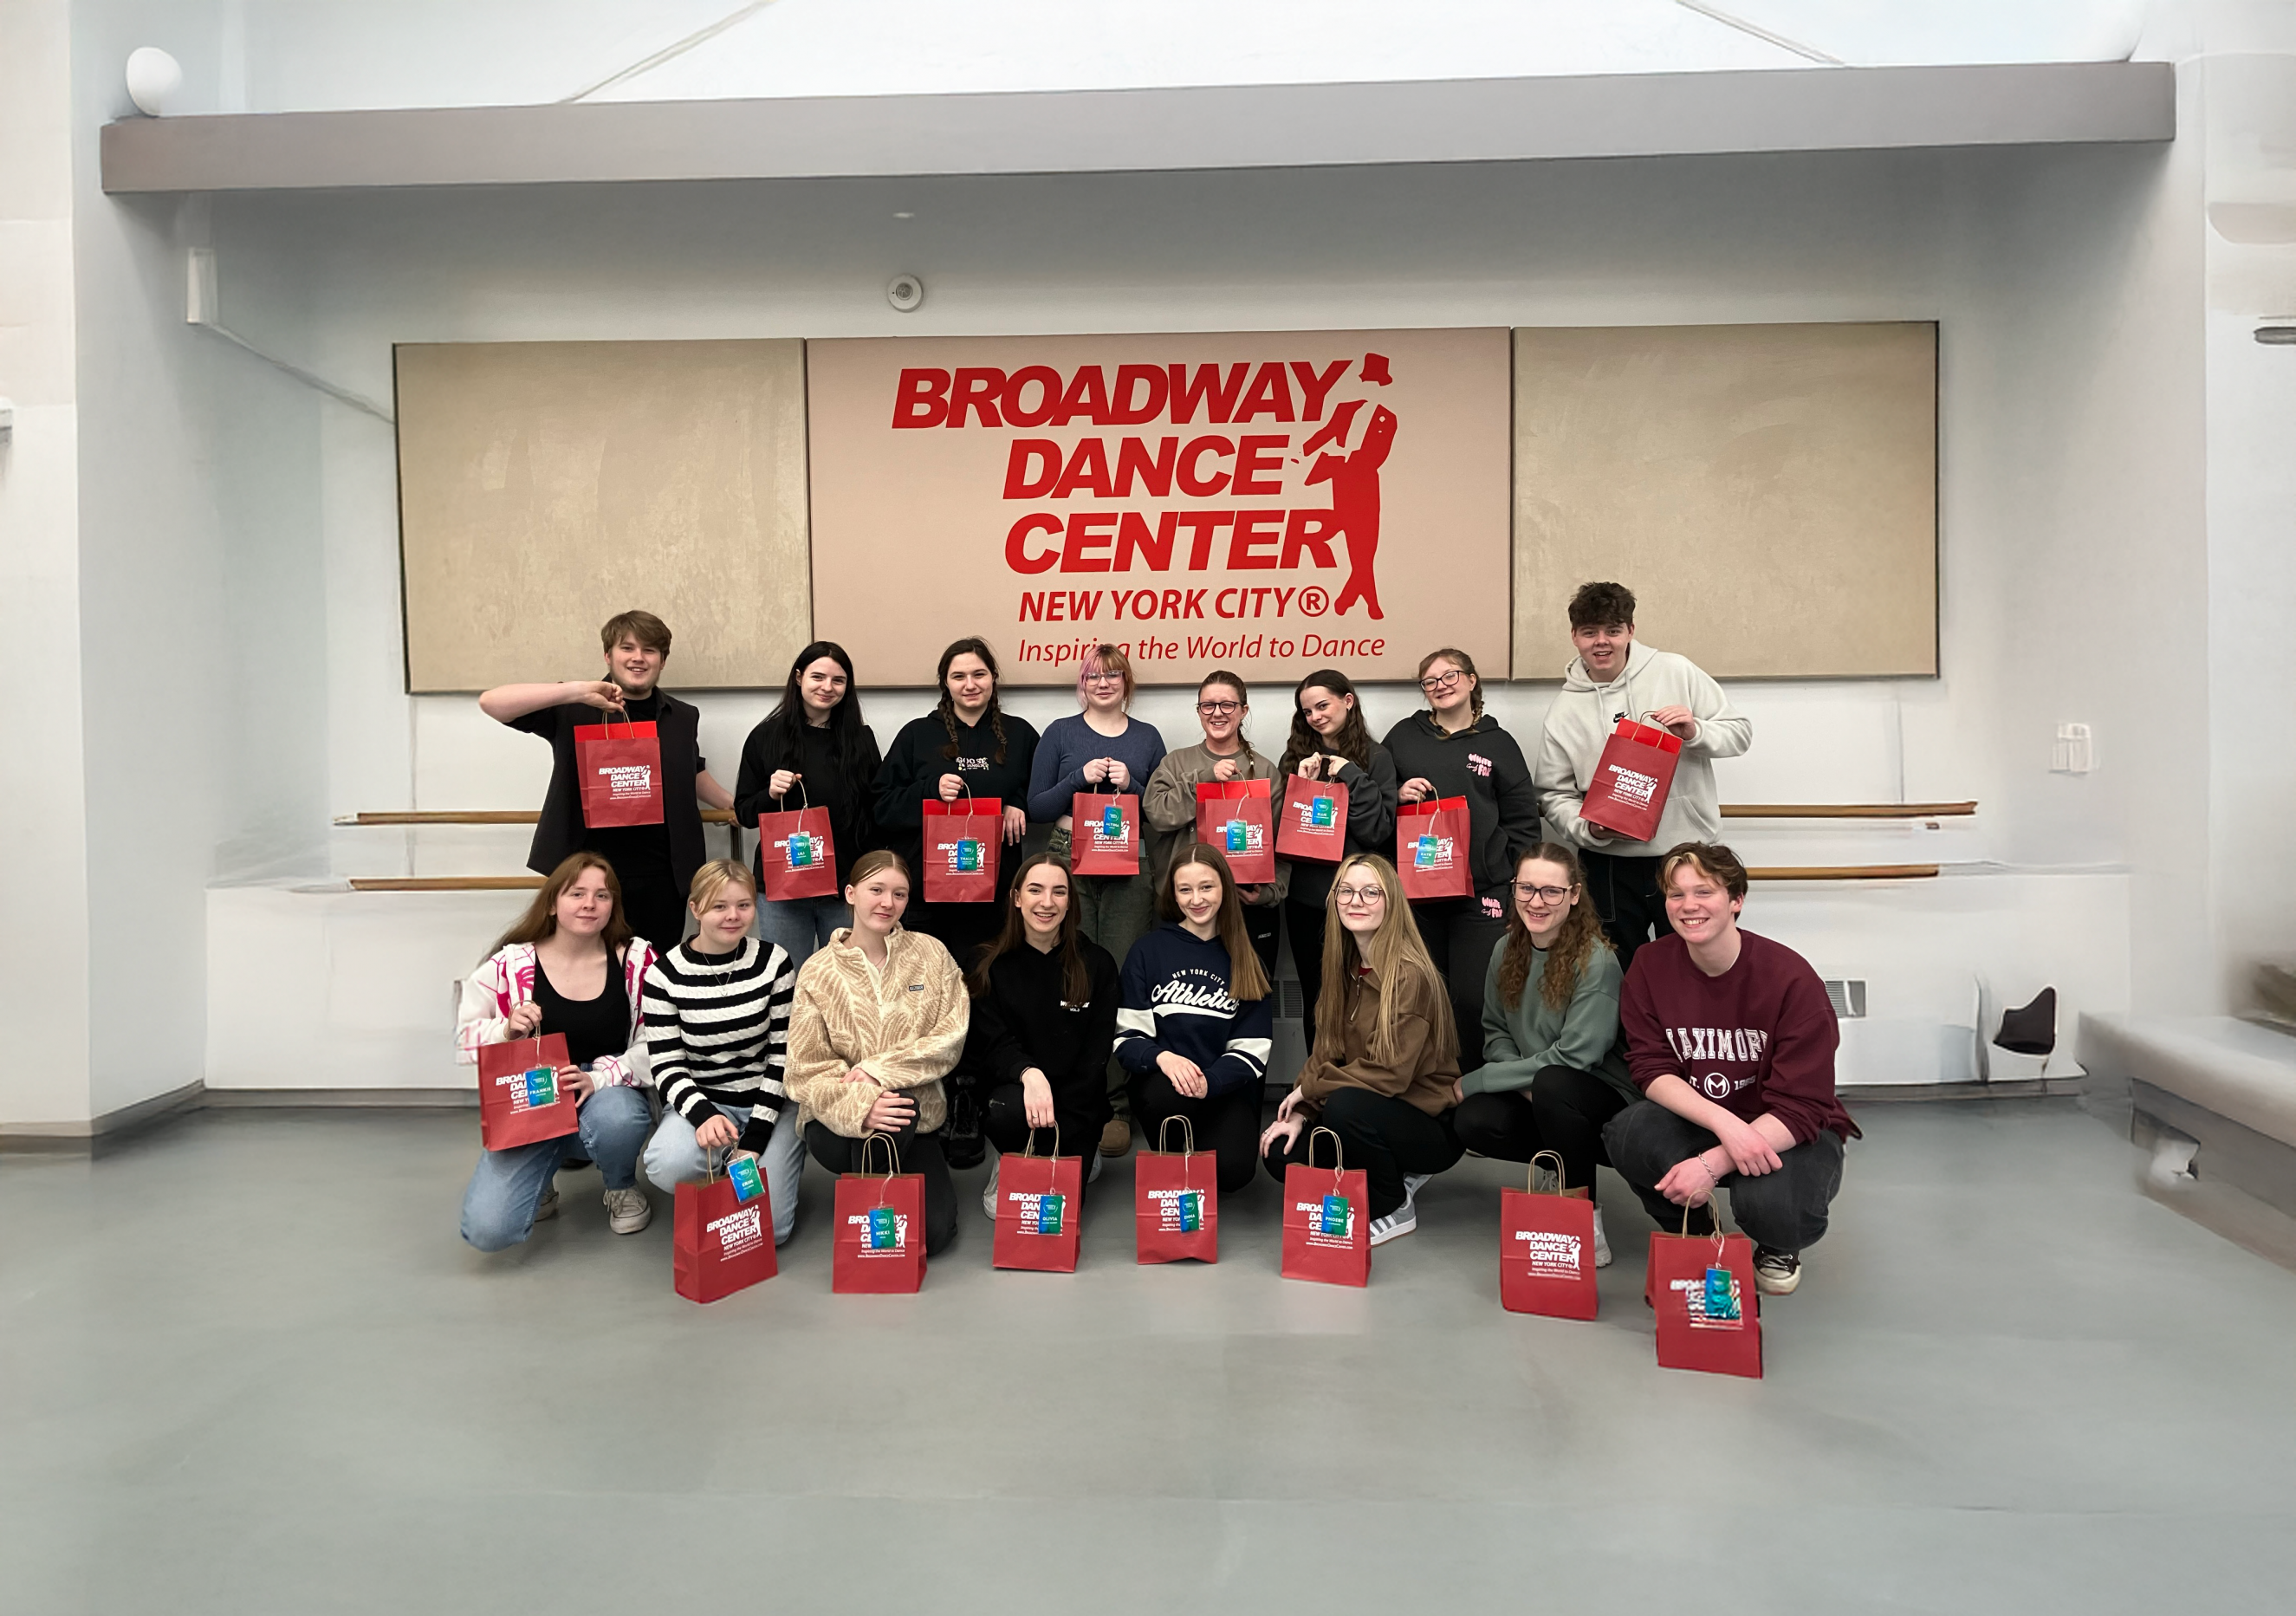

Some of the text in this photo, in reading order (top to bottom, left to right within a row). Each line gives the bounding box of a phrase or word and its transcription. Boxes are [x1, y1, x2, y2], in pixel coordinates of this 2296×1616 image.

[892, 360, 1353, 429] BROADWAY
[1002, 434, 1290, 499] DANCE
[1004, 509, 1337, 574] CENTER
[1018, 590, 1103, 622] NEW
[1111, 588, 1209, 620] YORK
[1138, 636, 1179, 660] the
[1187, 634, 1263, 659] World
[1269, 637, 1294, 659] to
[1301, 634, 1385, 657] Dance
[599, 766, 645, 775] BROADWAY
[1608, 764, 1654, 783] BROADWAY
[1615, 782, 1648, 798] CENTER
[1617, 775, 1646, 789] DANCE
[1171, 968, 1225, 986] NEW YORK CITY
[1021, 1202, 1041, 1210] DAN
[1021, 1210, 1040, 1220] CEN
[706, 1206, 755, 1233] BROADWAY
[719, 1216, 749, 1236] DANCE
[721, 1224, 757, 1245] CENTER
[1515, 1231, 1575, 1244] BROADWAY
[1529, 1241, 1567, 1252] DANCE
[1530, 1250, 1574, 1263] CENTER
